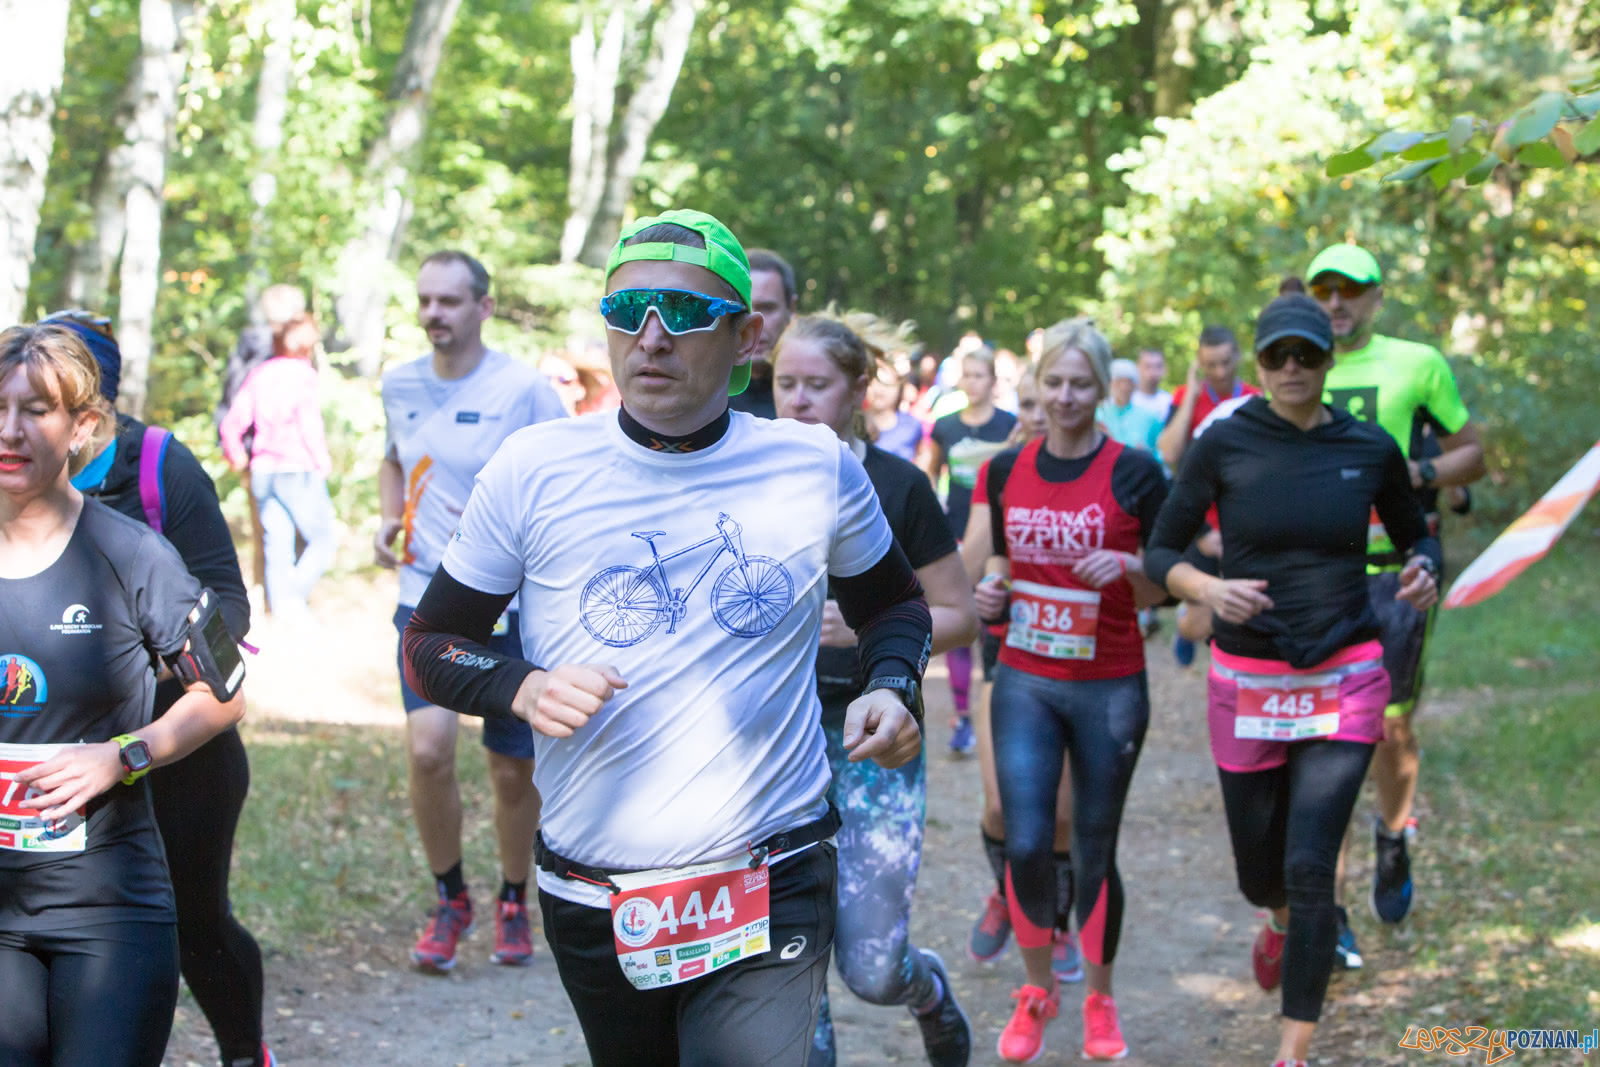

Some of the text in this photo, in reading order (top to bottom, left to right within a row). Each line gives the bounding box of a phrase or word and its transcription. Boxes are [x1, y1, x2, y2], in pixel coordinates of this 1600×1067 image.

[1007, 525, 1106, 551] SZPIKU
[1261, 693, 1315, 716] 445
[658, 886, 735, 935] 444
